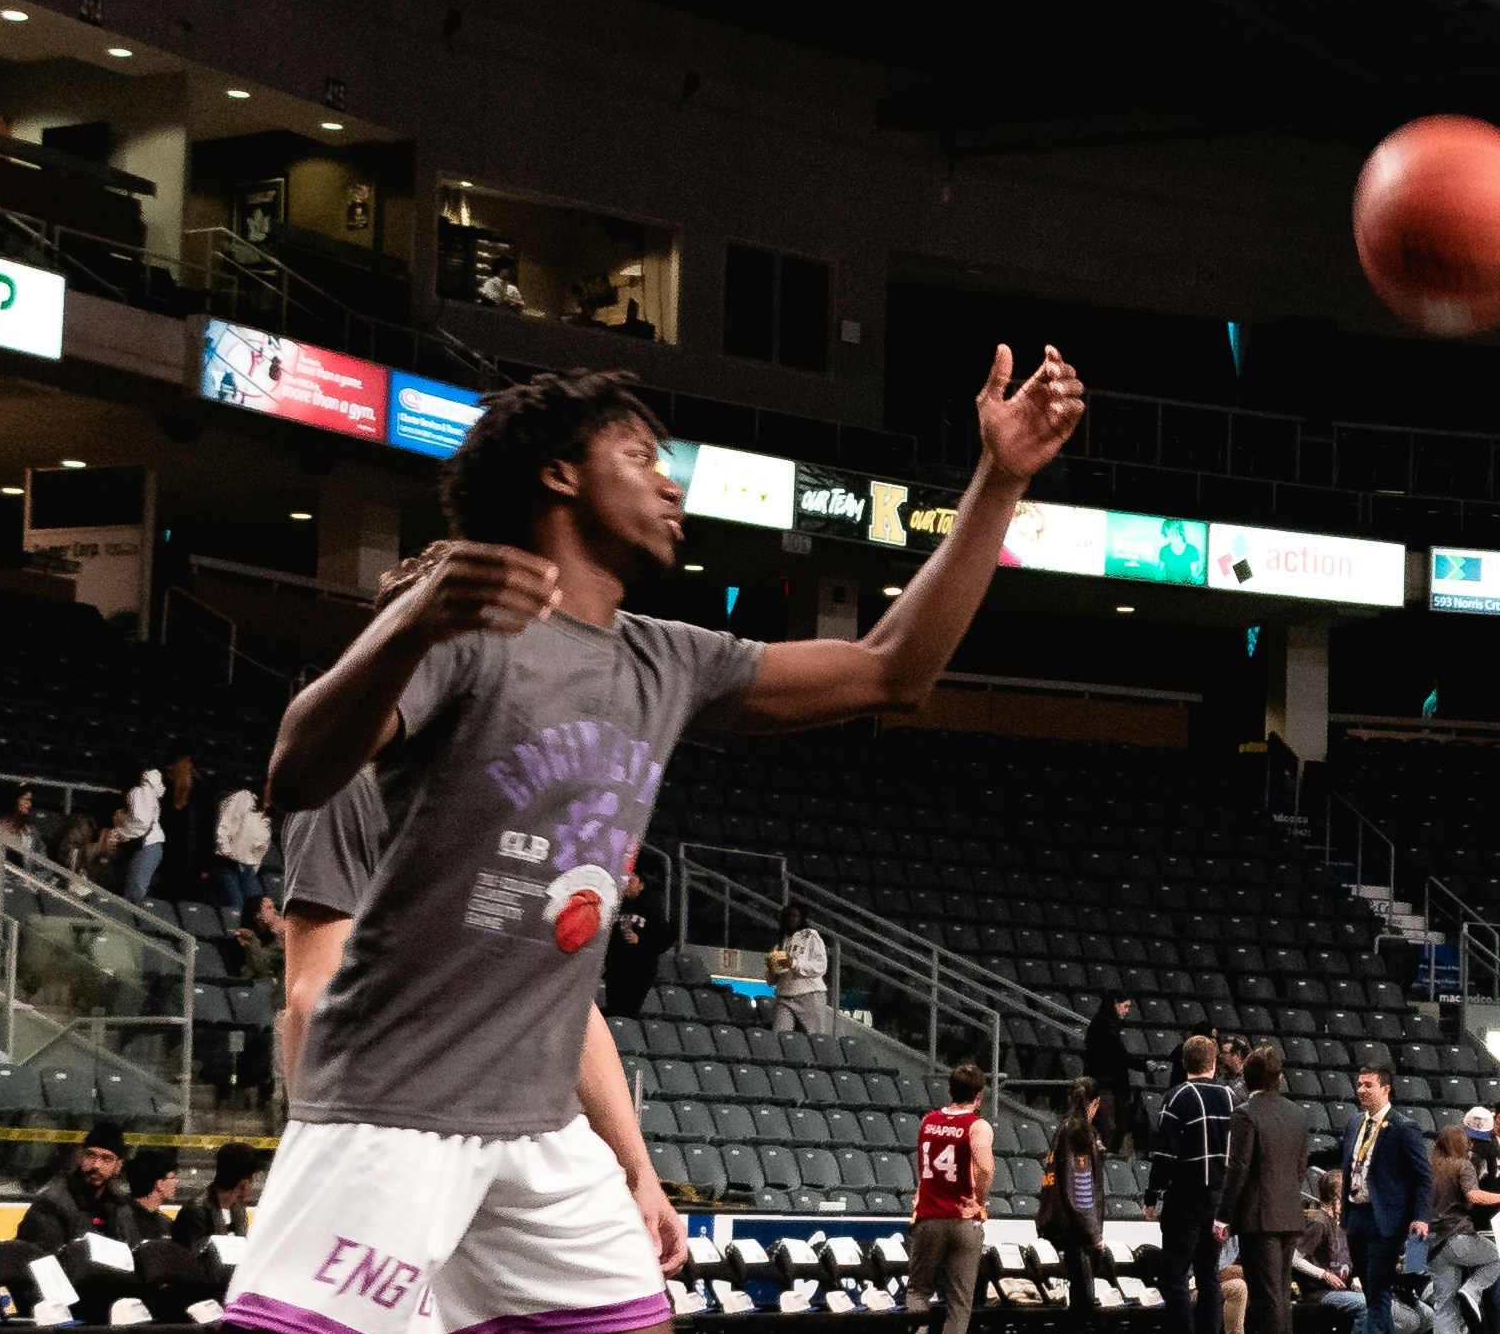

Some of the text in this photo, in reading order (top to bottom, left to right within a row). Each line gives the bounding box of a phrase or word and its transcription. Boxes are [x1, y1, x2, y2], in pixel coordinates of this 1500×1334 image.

[312, 391, 340, 410] than
[340, 401, 349, 413] a
[349, 403, 376, 421] gym.
[802, 488, 865, 523] OUR TEAM
[868, 481, 908, 546] K
[910, 510, 937, 534] OUR
[1266, 547, 1352, 578] action
[1434, 596, 1452, 607] 593
[1453, 598, 1483, 611] Norris
[923, 1123, 965, 1139] SHAPIRO
[921, 1141, 958, 1183] 14
[314, 1235, 420, 1310] ENG
